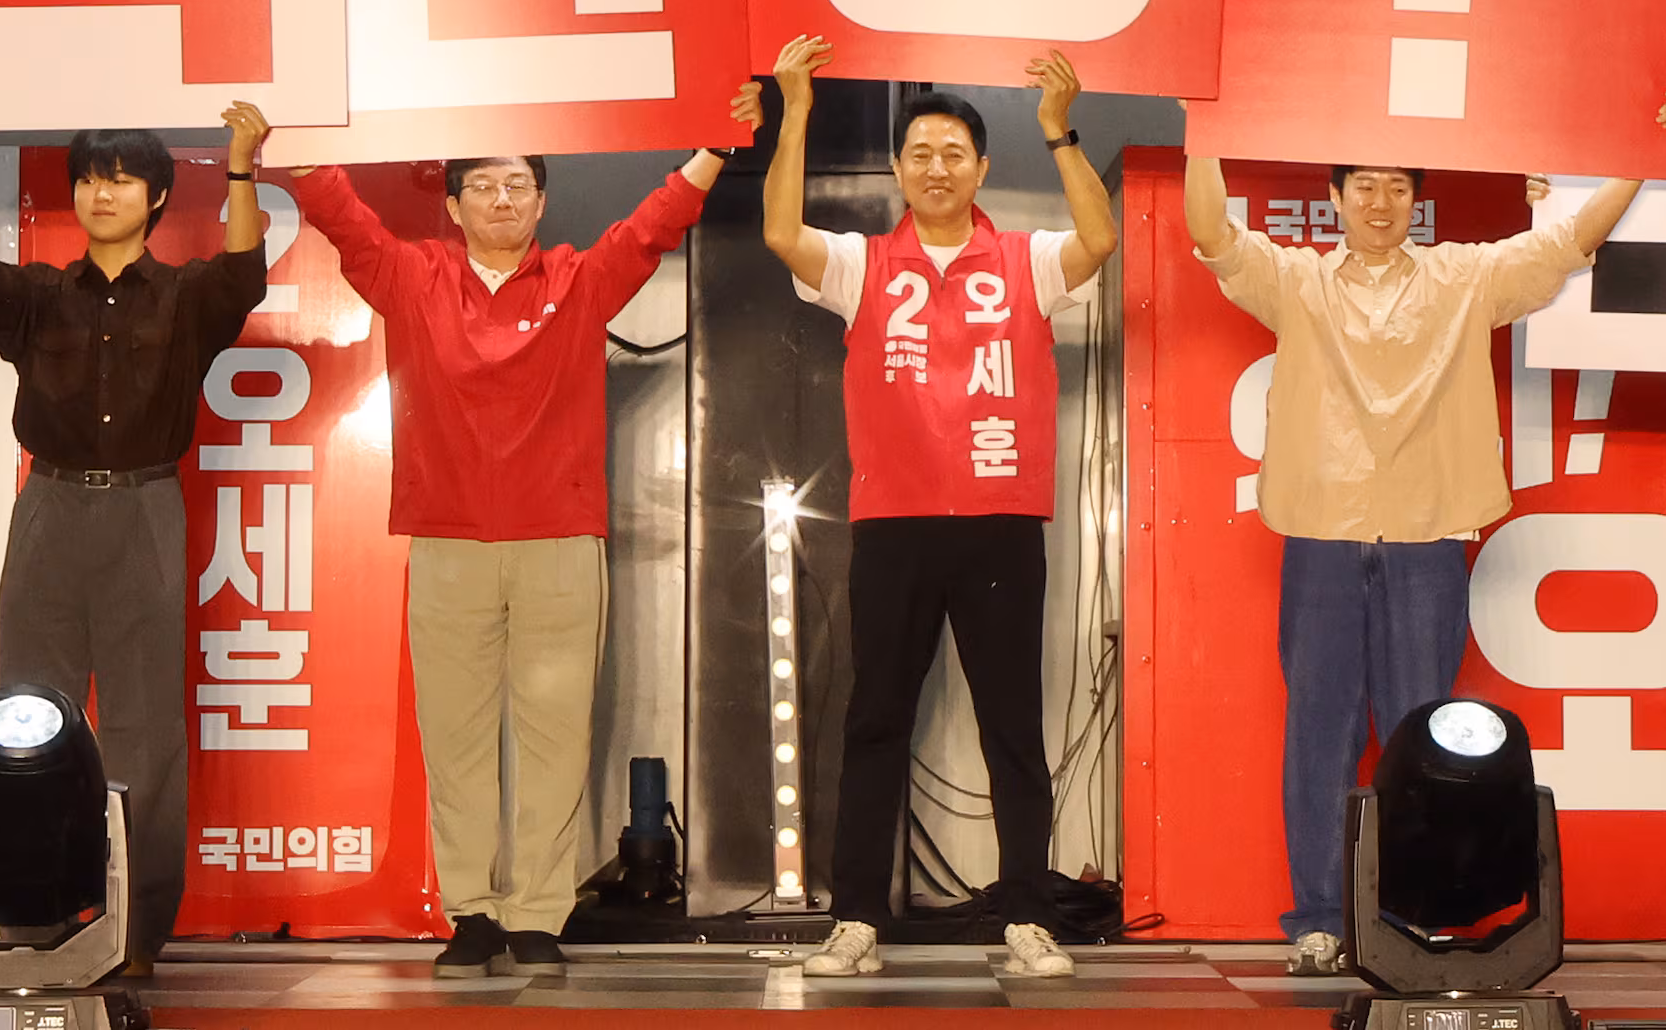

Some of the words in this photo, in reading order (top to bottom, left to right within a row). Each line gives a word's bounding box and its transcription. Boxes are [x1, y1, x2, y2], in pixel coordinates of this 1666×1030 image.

[885, 270, 930, 340] 2
[965, 271, 1019, 478] 오세훈
[197, 346, 314, 751] 오세훈
[199, 826, 373, 874] 국민의힘
